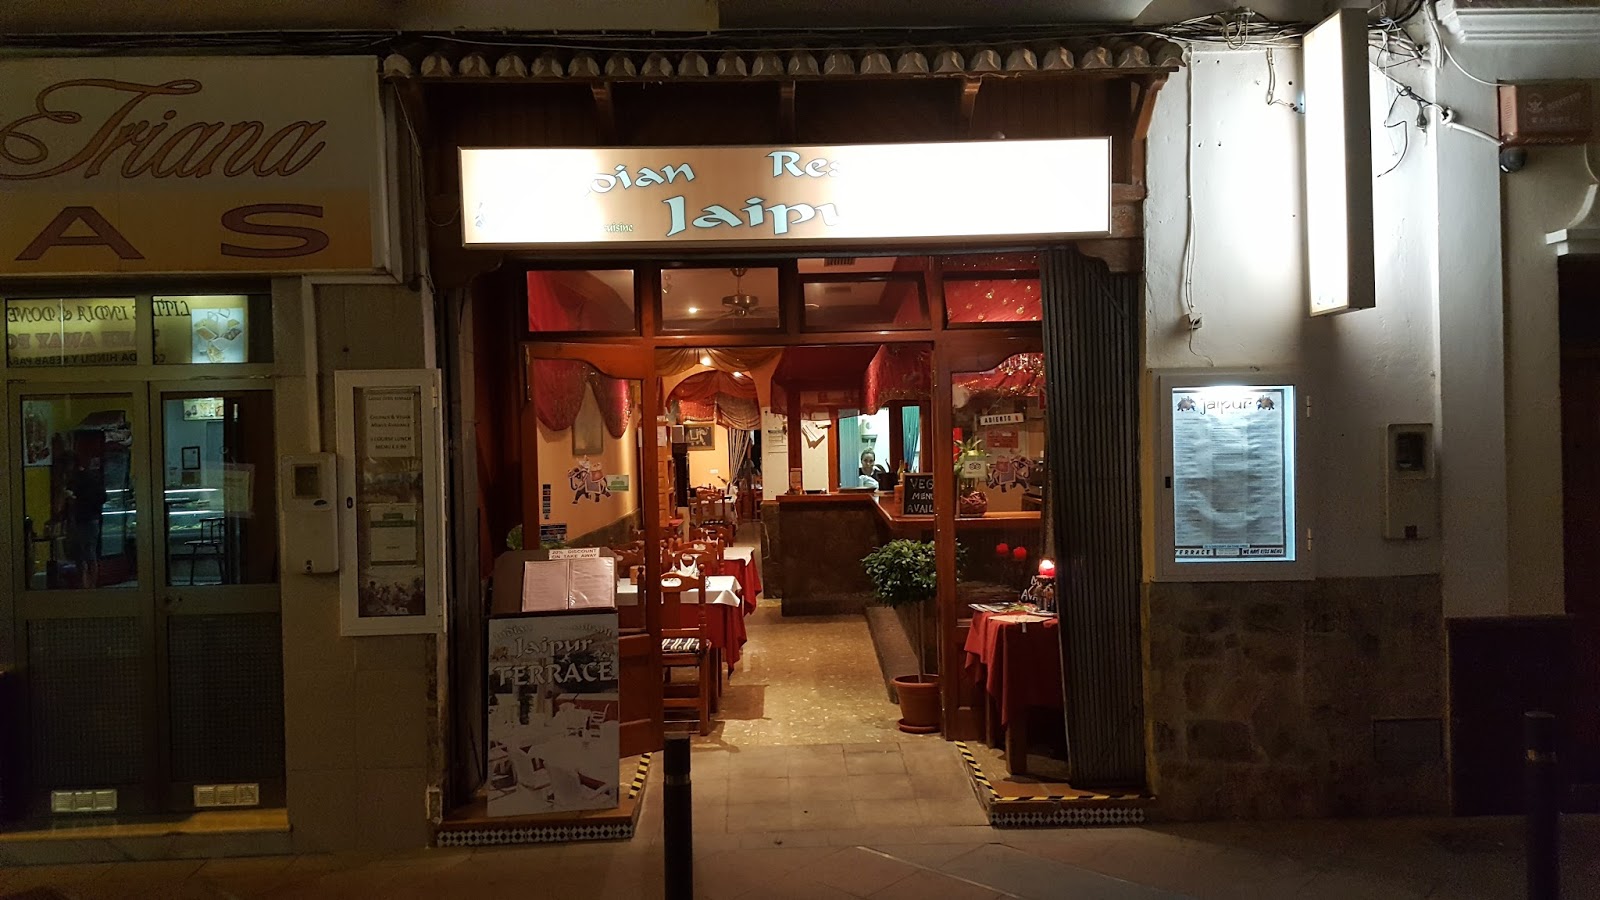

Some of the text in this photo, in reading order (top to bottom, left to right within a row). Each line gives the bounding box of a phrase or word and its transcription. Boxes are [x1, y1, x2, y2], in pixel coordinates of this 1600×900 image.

[0, 78, 327, 181] Triana
[984, 415, 1011, 424] ABIERTO
[514, 636, 594, 659] Jaipur
[493, 661, 612, 687] TERRACE
